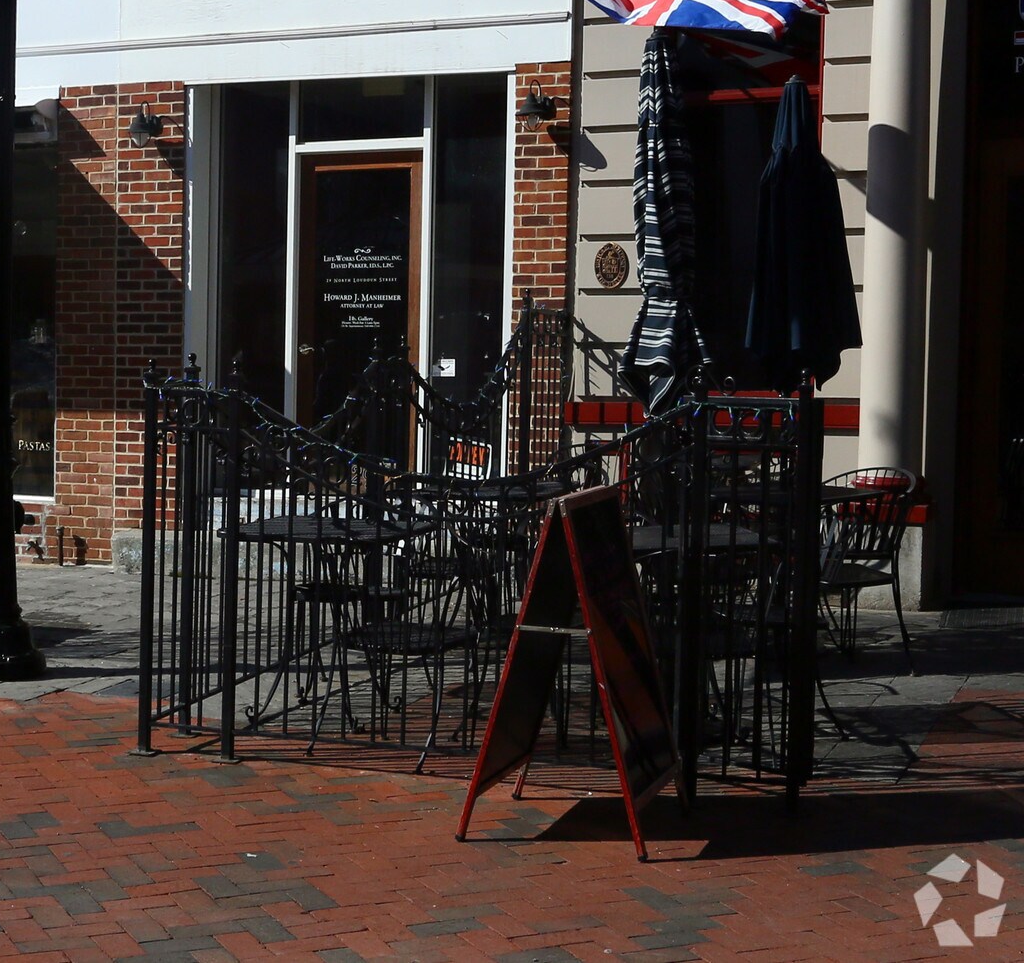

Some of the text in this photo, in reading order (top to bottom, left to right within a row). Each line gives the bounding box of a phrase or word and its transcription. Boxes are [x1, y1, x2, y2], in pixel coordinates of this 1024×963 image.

[323, 293, 353, 302] HOWARD
[361, 293, 401, 302] MANHEIMER
[18, 439, 51, 451] PASTAS
